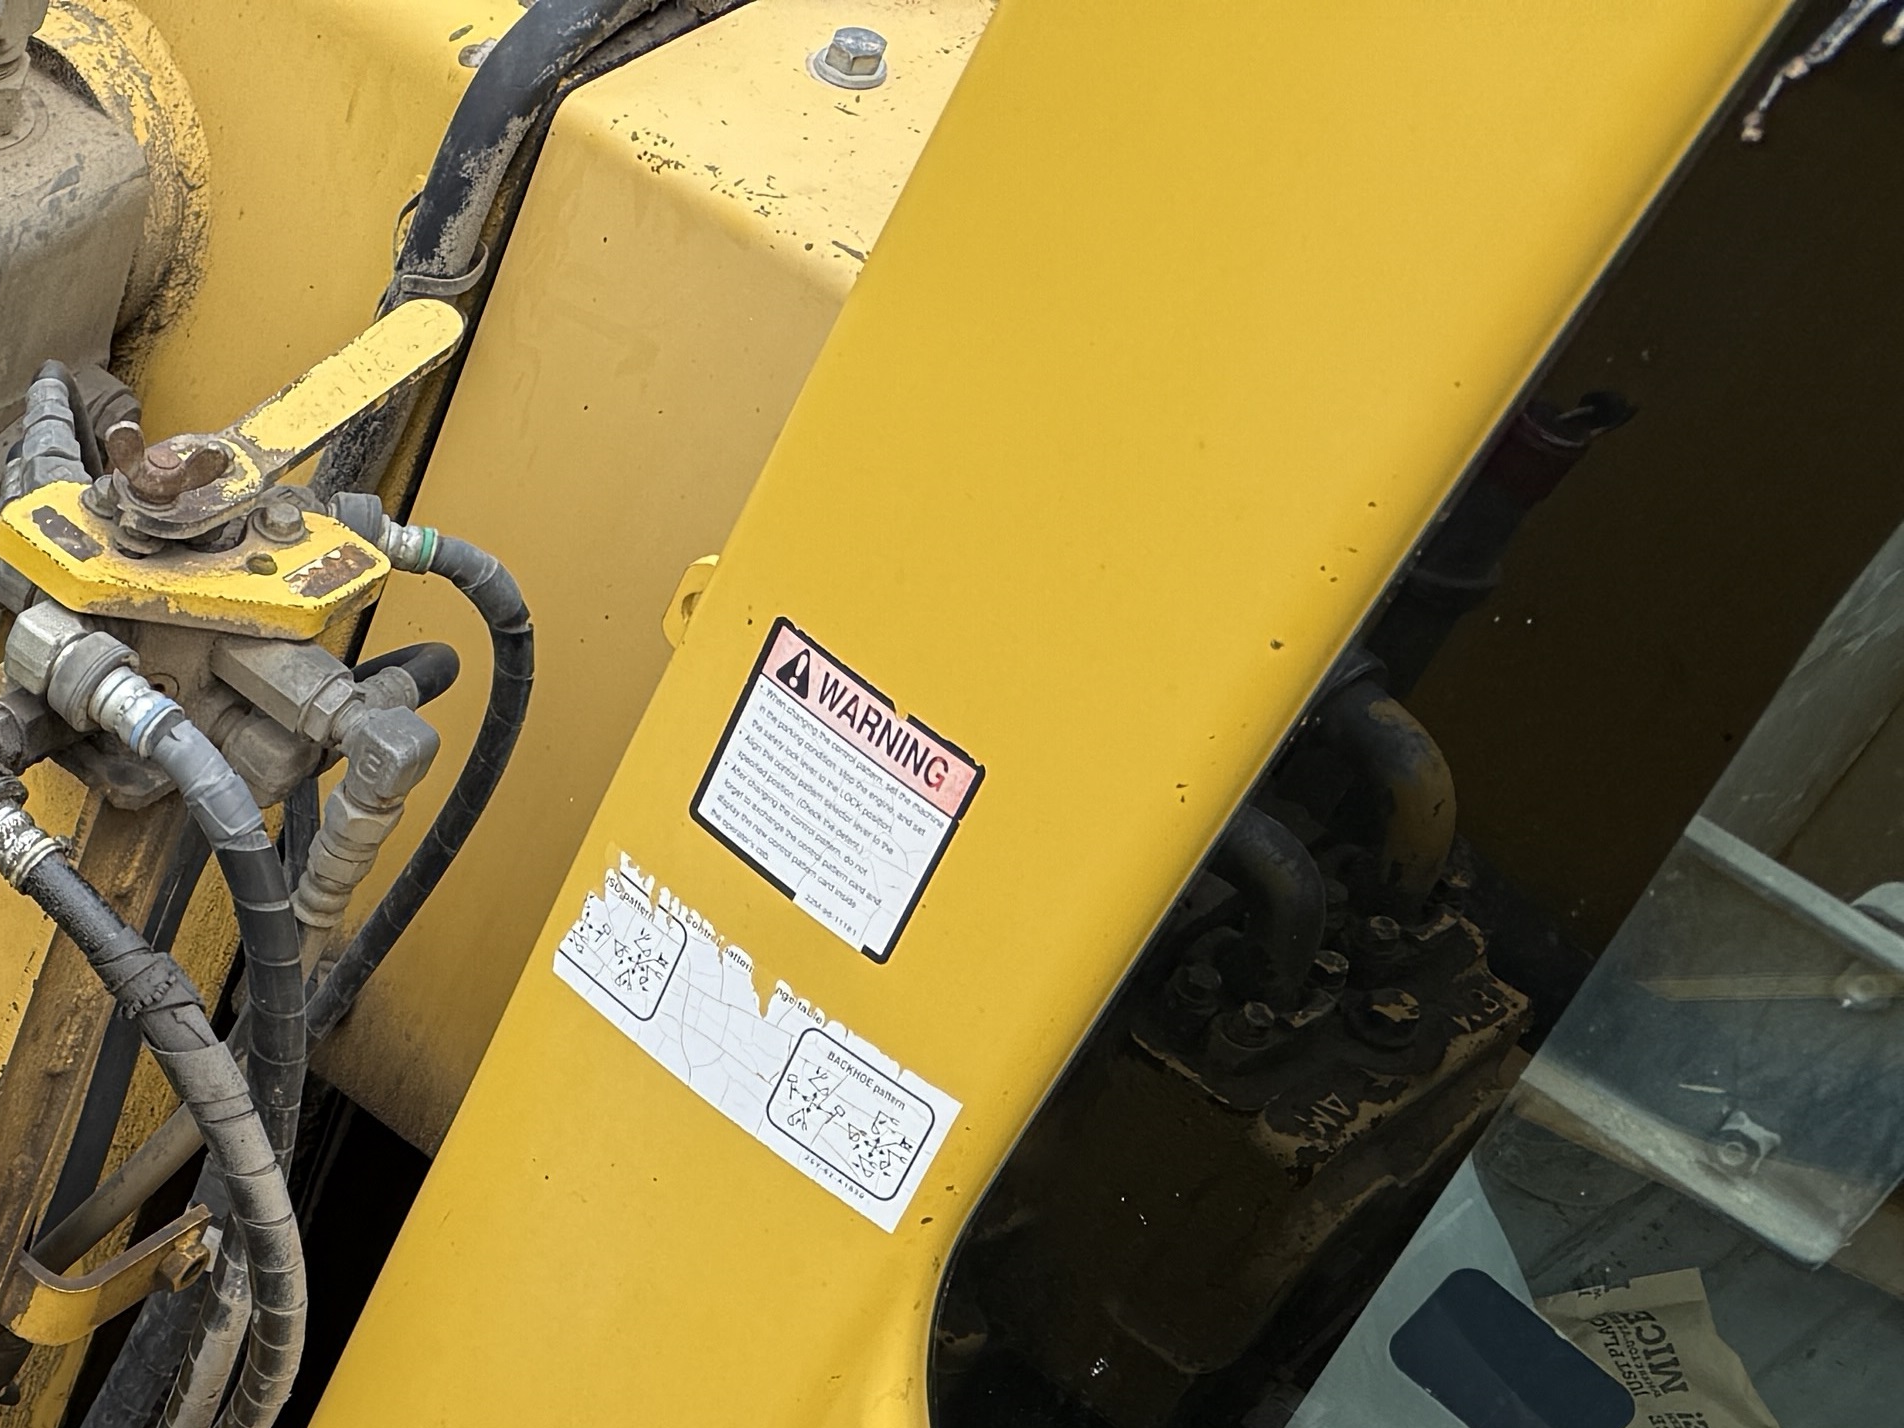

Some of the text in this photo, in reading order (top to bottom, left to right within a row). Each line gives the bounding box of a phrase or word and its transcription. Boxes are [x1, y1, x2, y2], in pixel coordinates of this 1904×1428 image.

[750, 719, 764, 732] the
[761, 729, 785, 751] safety
[783, 746, 800, 761] lock
[798, 758, 818, 776] lever
[825, 779, 840, 793] the
[838, 789, 862, 810] LOCK
[764, 688, 789, 710] When
[784, 706, 819, 736] changing
[816, 730, 832, 745] the
[830, 741, 857, 764] control
[885, 782, 900, 796] set
[897, 791, 912, 805] the
[911, 801, 945, 829] machine
[765, 711, 779, 723] the
[775, 720, 805, 745] parking
[837, 768, 856, 785] stop
[855, 781, 869, 794] the
[895, 811, 913, 827] and
[911, 823, 926, 837] set
[818, 671, 949, 792] WARNING
[709, 808, 722, 820] the
[721, 818, 757, 848] operator's
[721, 778, 745, 799] forget
[749, 802, 786, 832] exchange
[783, 829, 797, 841] the
[796, 839, 822, 861] control
[821, 858, 849, 882] pattern
[848, 878, 866, 894] card
[865, 891, 881, 906] and
[730, 764, 748, 780] After
[744, 778, 780, 808] changing
[777, 803, 791, 816] the
[789, 813, 816, 836] control
[842, 854, 855, 866] do
[853, 863, 868, 876] not
[735, 750, 768, 778] specified
[795, 797, 823, 822] (Check
[821, 818, 836, 830] the
[743, 734, 763, 753] Align
[761, 749, 775, 762] the
[772, 759, 799, 781] control
[796, 778, 824, 802] pattern
[822, 798, 852, 823] selector
[852, 820, 872, 838] lever
[880, 841, 895, 855] the
[619, 890, 659, 922] pattern
[714, 794, 857, 908] display the new control pattern card inside
[682, 913, 724, 946] Contrl
[795, 1000, 825, 1025] table
[825, 1050, 908, 1111] BACKHOE pattern
[1589, 1315, 1625, 1361] PLAC
[1614, 1358, 1649, 1397] JUST
